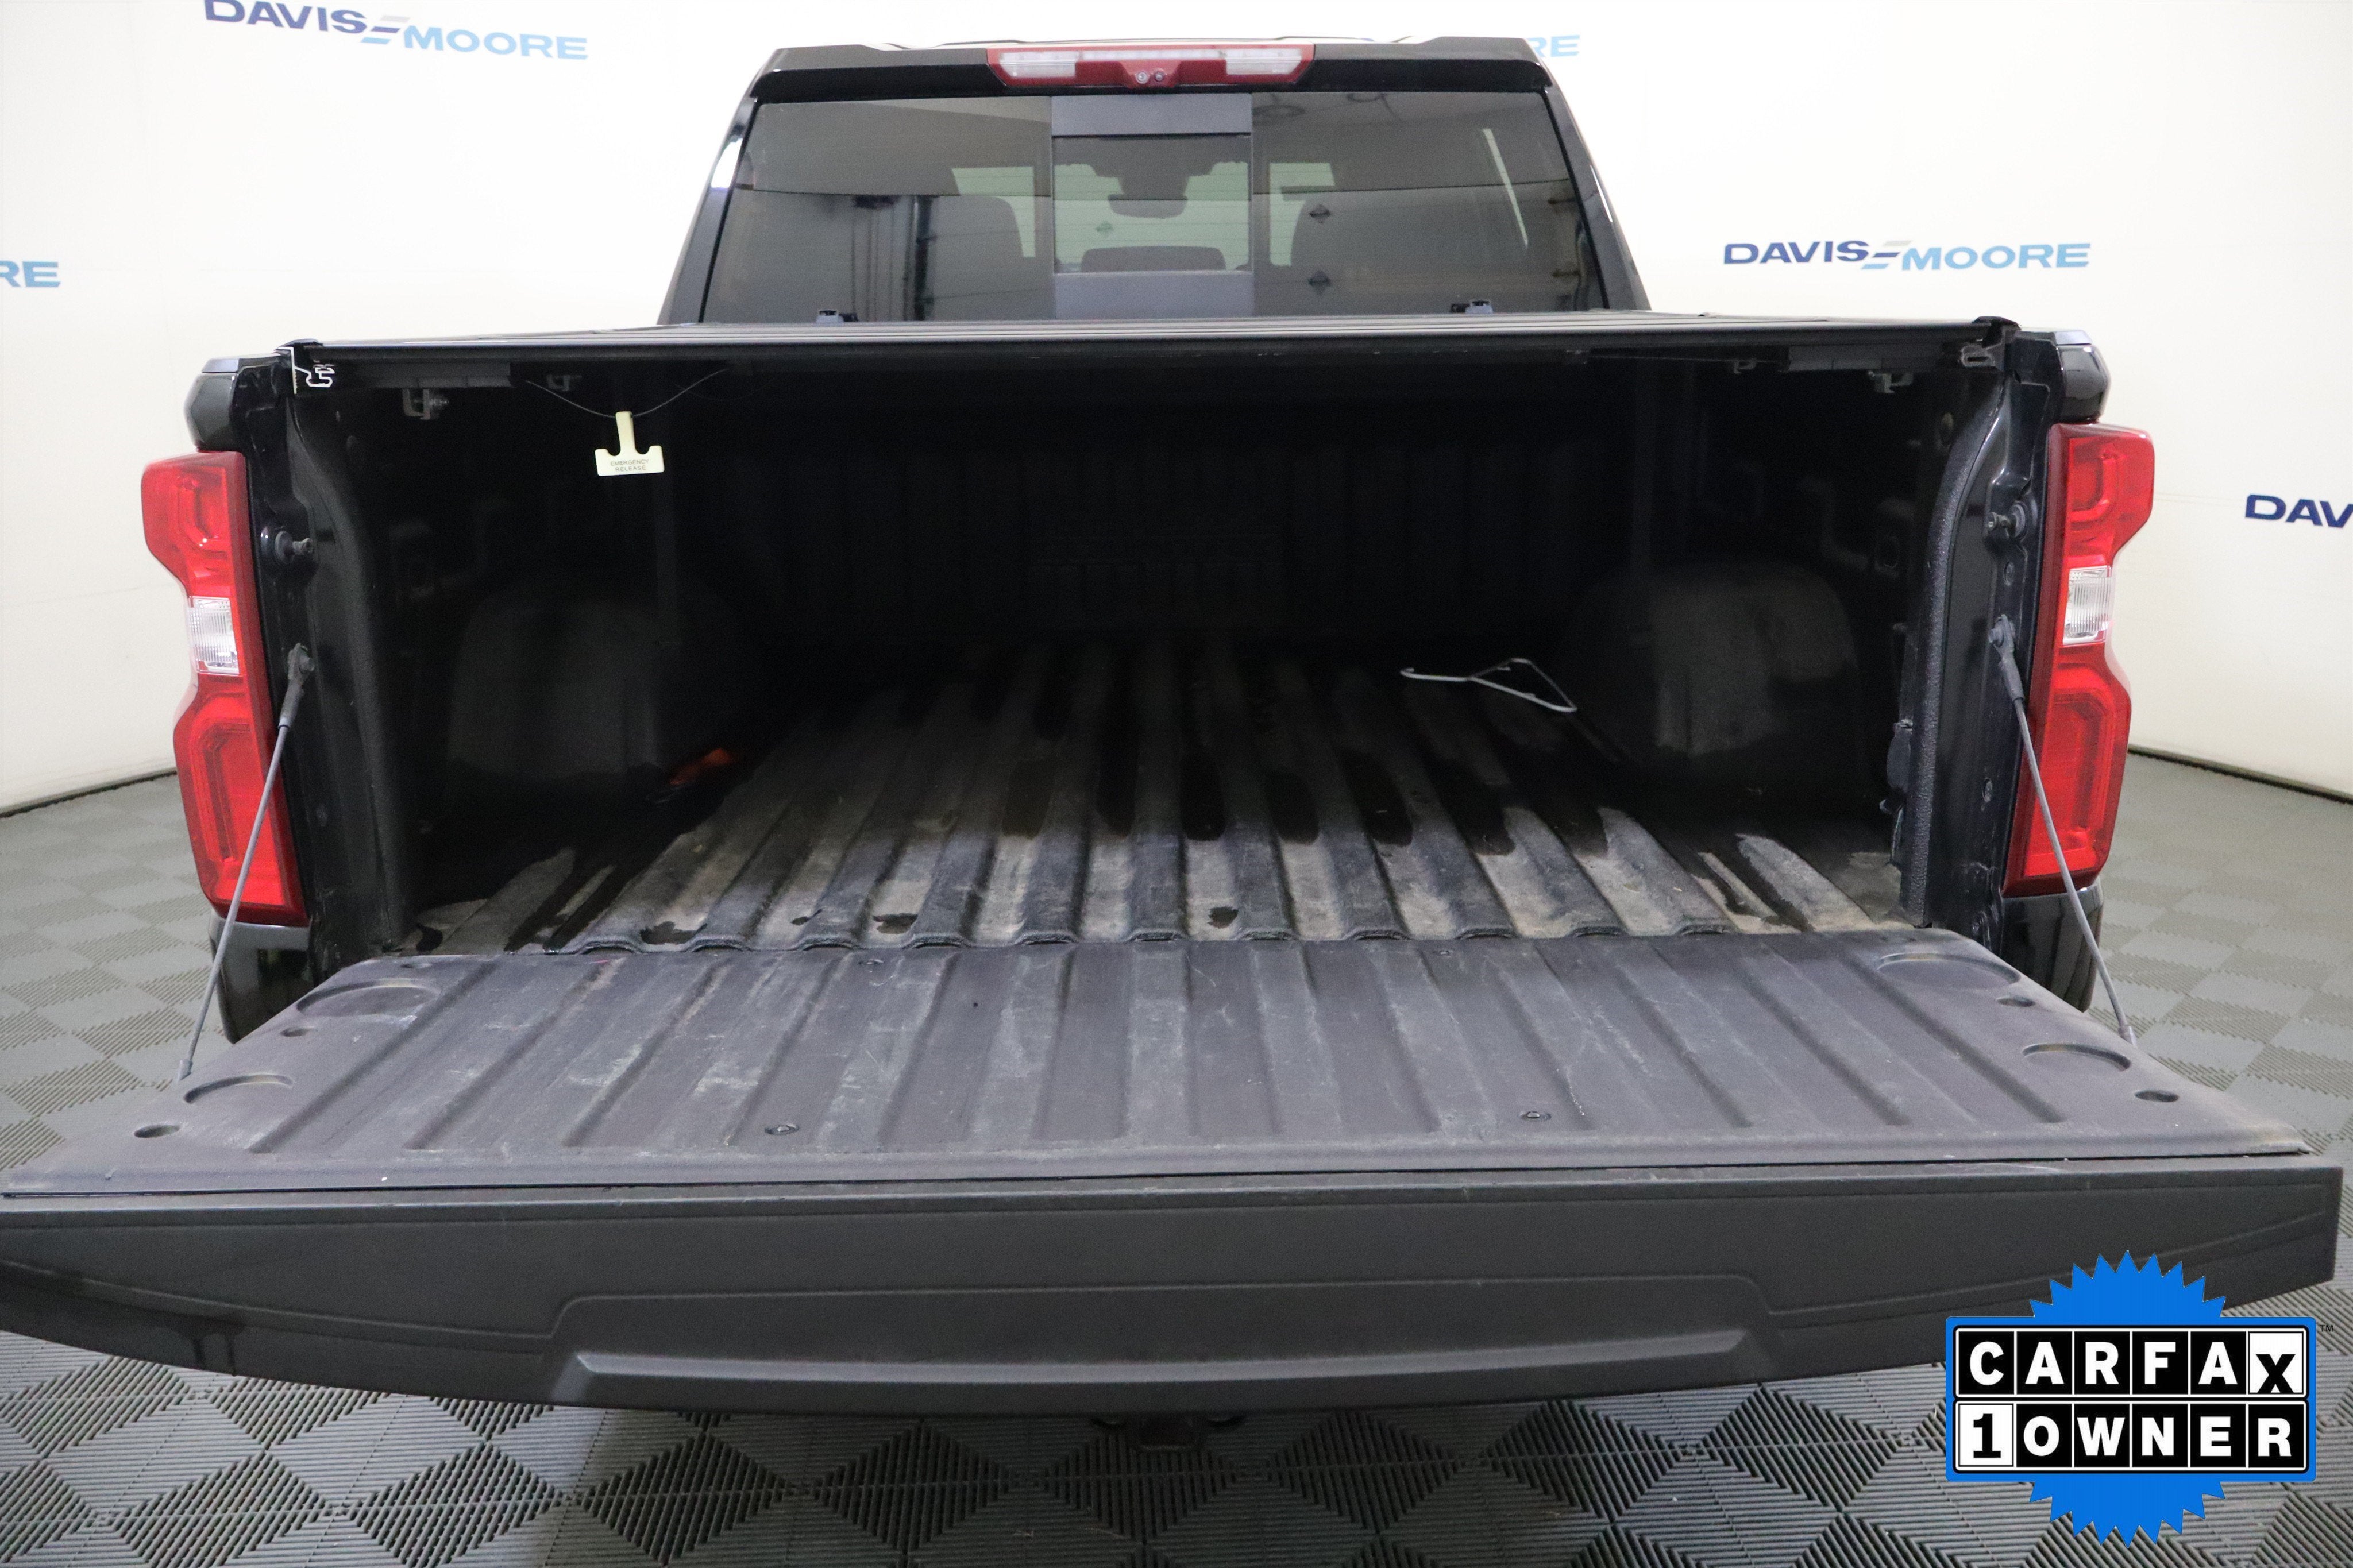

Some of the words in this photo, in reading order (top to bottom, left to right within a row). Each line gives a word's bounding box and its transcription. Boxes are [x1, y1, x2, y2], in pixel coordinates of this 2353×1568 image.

[205, 0, 367, 34] DAVIS
[403, 25, 588, 60] MOORE
[1723, 240, 1870, 265] DAVIS
[1901, 243, 2091, 271] MOORE
